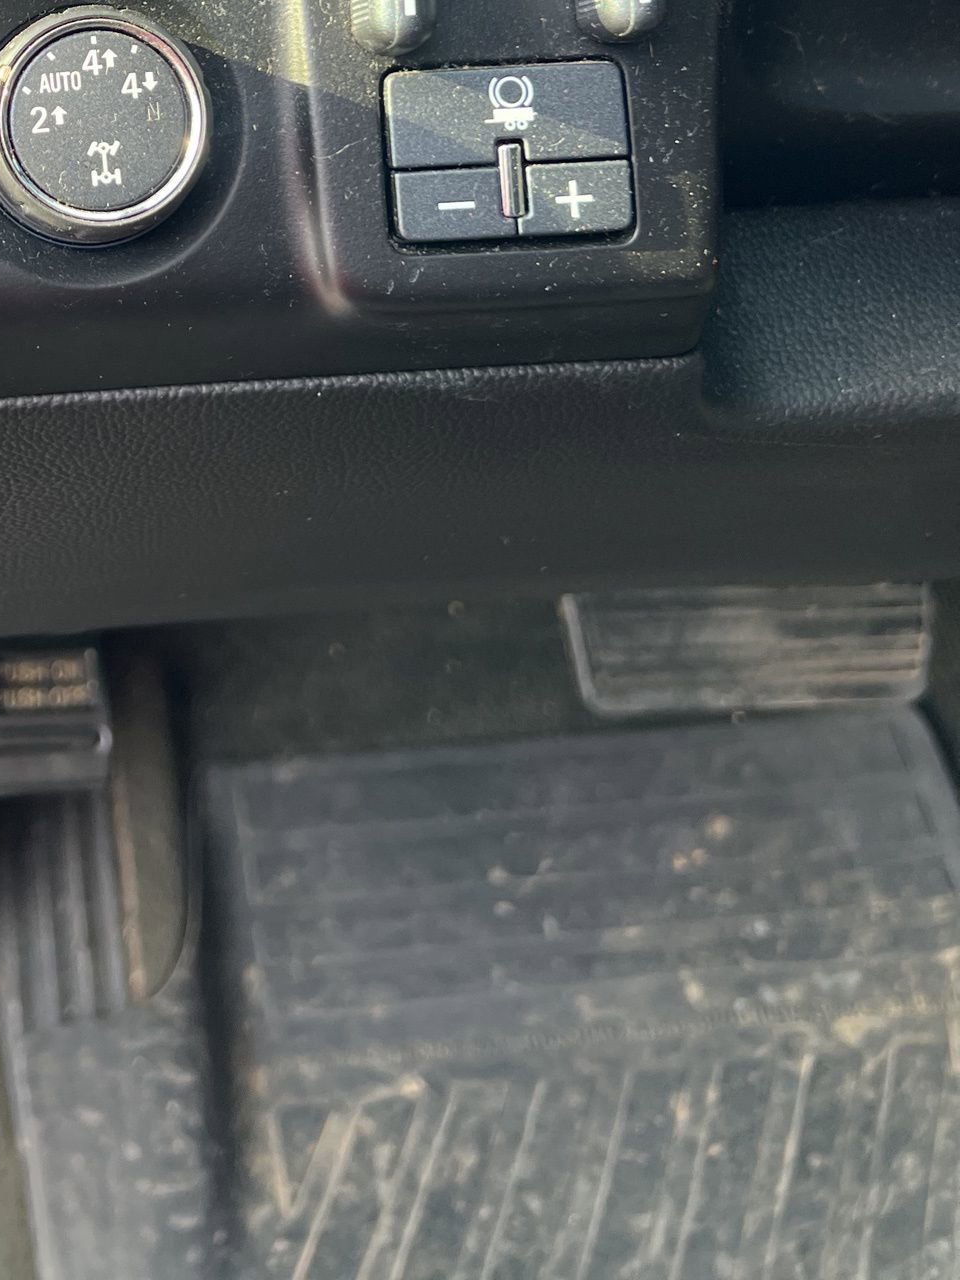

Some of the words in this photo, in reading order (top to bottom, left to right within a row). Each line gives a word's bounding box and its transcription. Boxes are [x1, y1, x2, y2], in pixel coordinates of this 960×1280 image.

[82, 49, 103, 76] 4
[39, 71, 82, 94] AUTO
[120, 73, 142, 99] 4
[30, 106, 50, 134] 2
